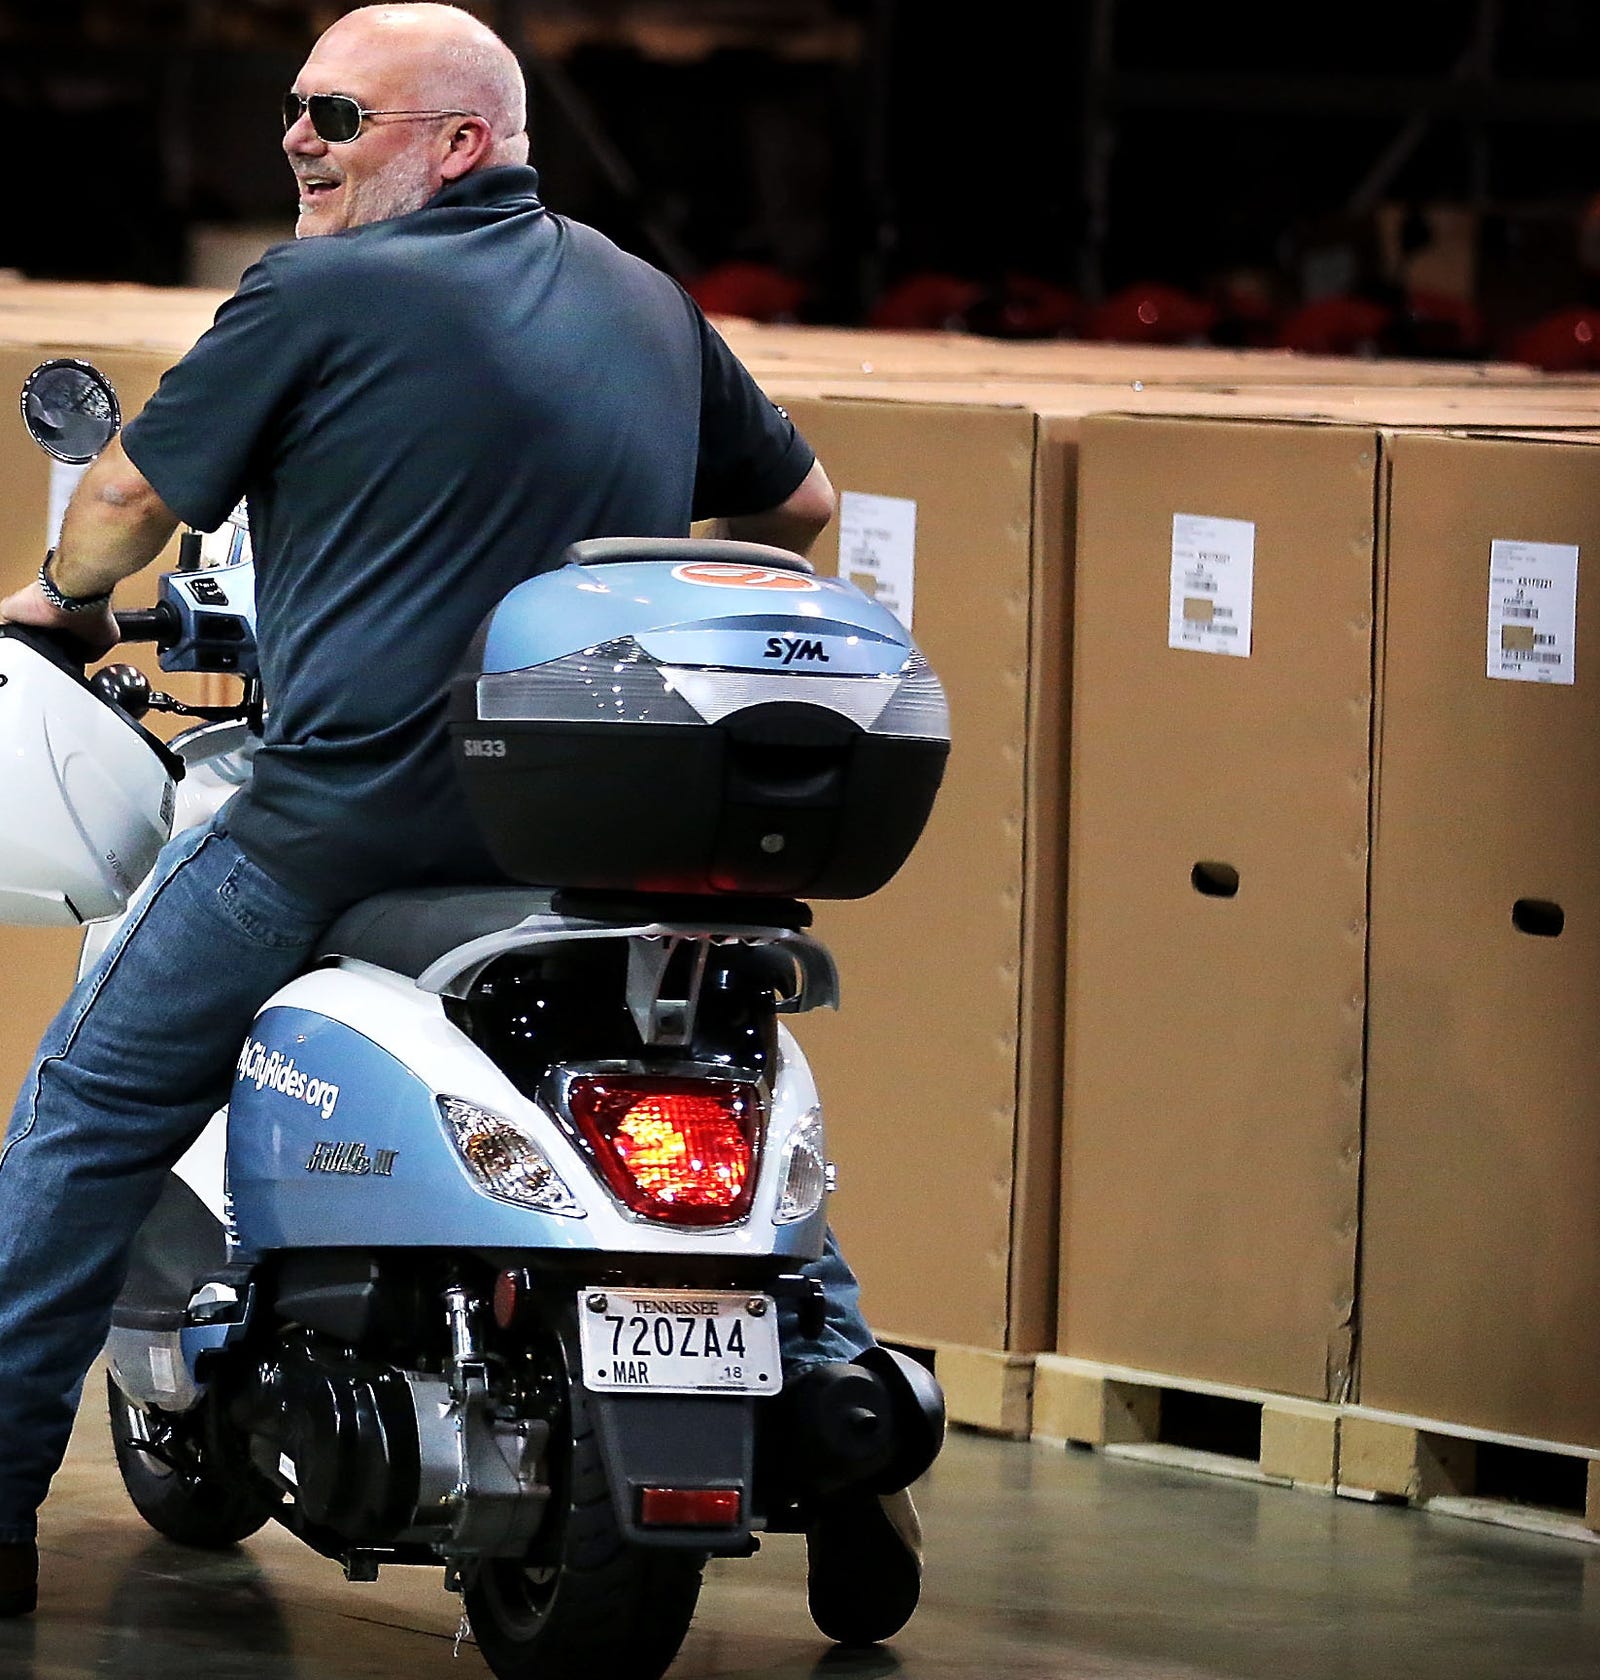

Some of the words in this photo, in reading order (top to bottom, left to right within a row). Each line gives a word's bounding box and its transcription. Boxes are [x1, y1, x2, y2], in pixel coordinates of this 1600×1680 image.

[764, 637, 830, 665] SYM
[633, 1300, 719, 1316] TENNESSEE
[604, 1315, 746, 1359] 720ZA4
[613, 1360, 649, 1384] MAR
[724, 1366, 743, 1379] 18
